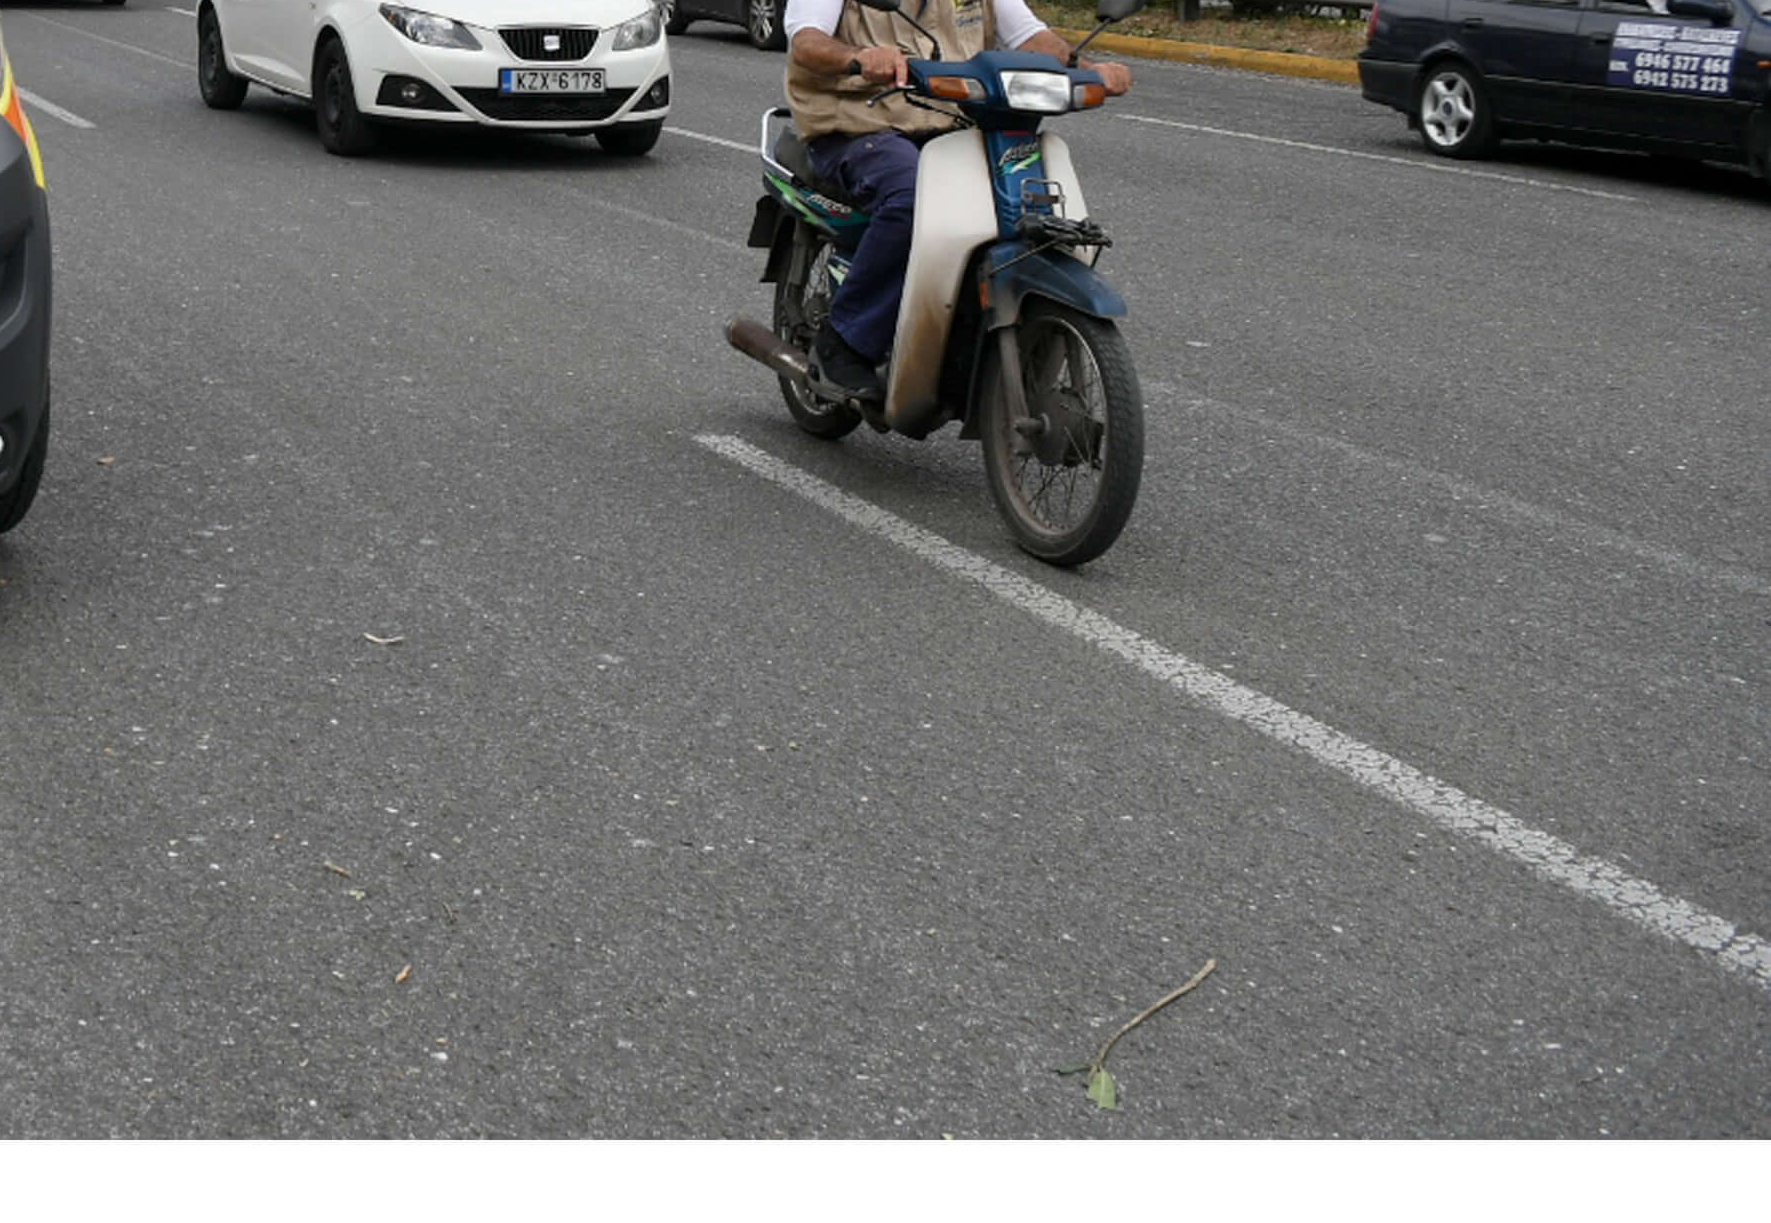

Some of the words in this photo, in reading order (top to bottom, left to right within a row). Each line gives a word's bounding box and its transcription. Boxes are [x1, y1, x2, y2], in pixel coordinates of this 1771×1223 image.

[1633, 69, 1669, 87] 6942
[1670, 73, 1699, 89] 575
[1700, 75, 1729, 93] 273
